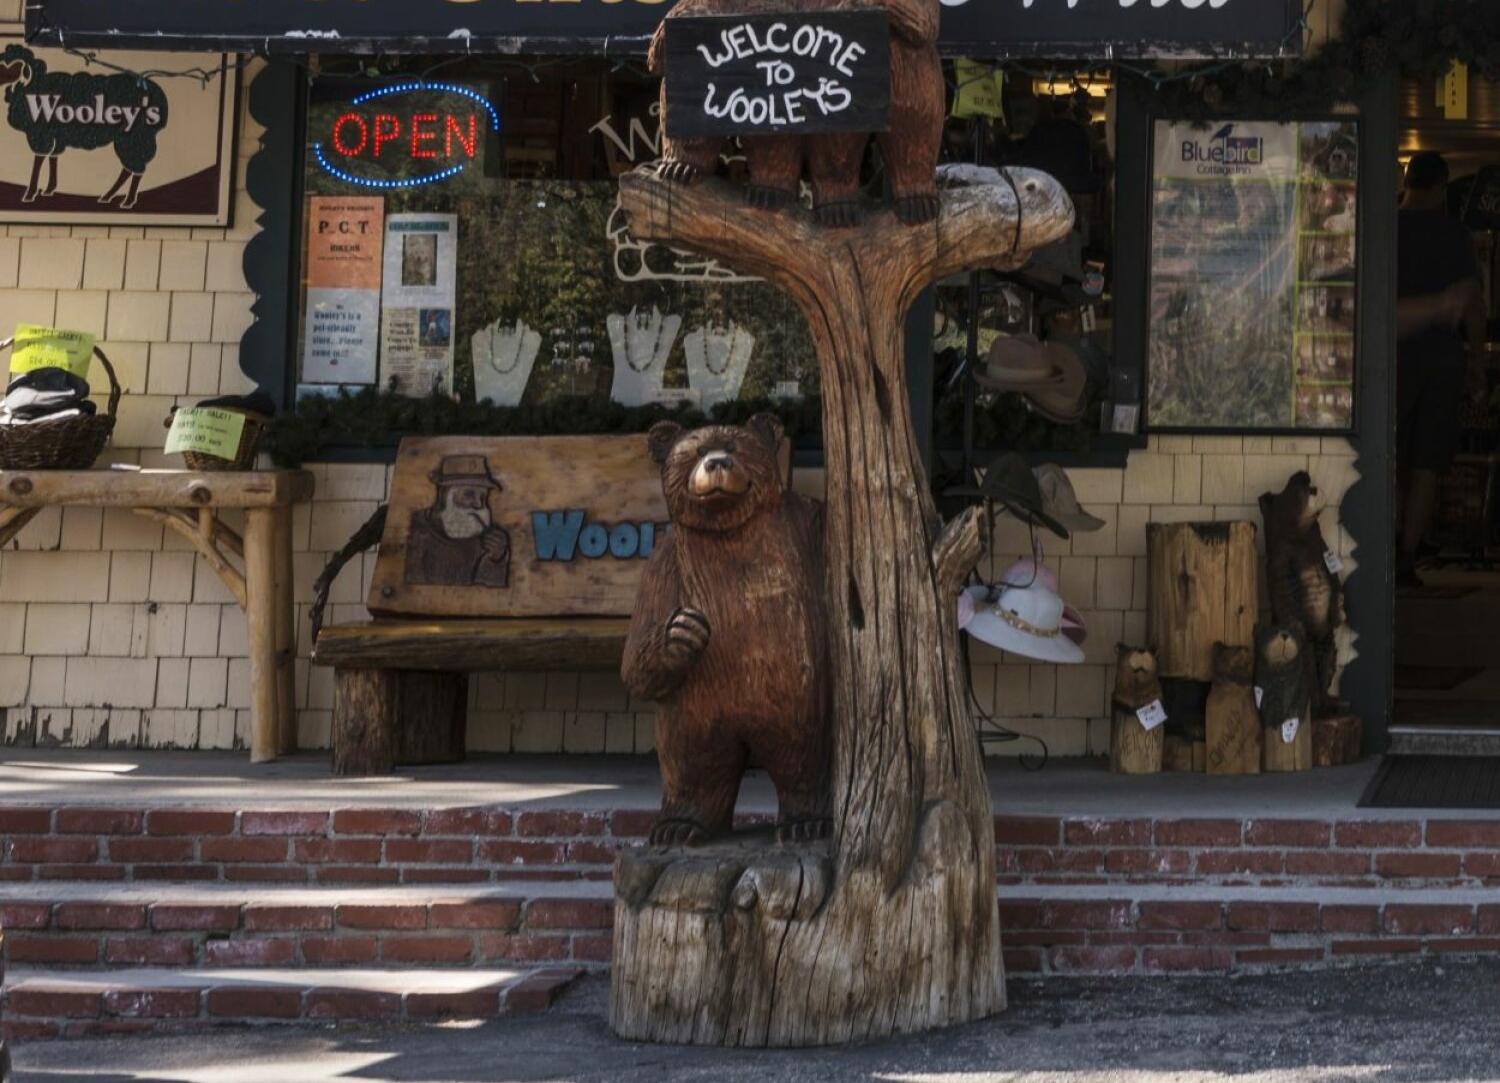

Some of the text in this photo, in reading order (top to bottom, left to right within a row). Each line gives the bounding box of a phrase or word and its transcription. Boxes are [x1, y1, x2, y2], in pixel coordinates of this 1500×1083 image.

[697, 23, 866, 77] WELCOME
[756, 59, 795, 87] TO
[25, 94, 160, 133] Wooley's
[332, 112, 476, 159] OPEN
[1181, 136, 1263, 164] Bluebird
